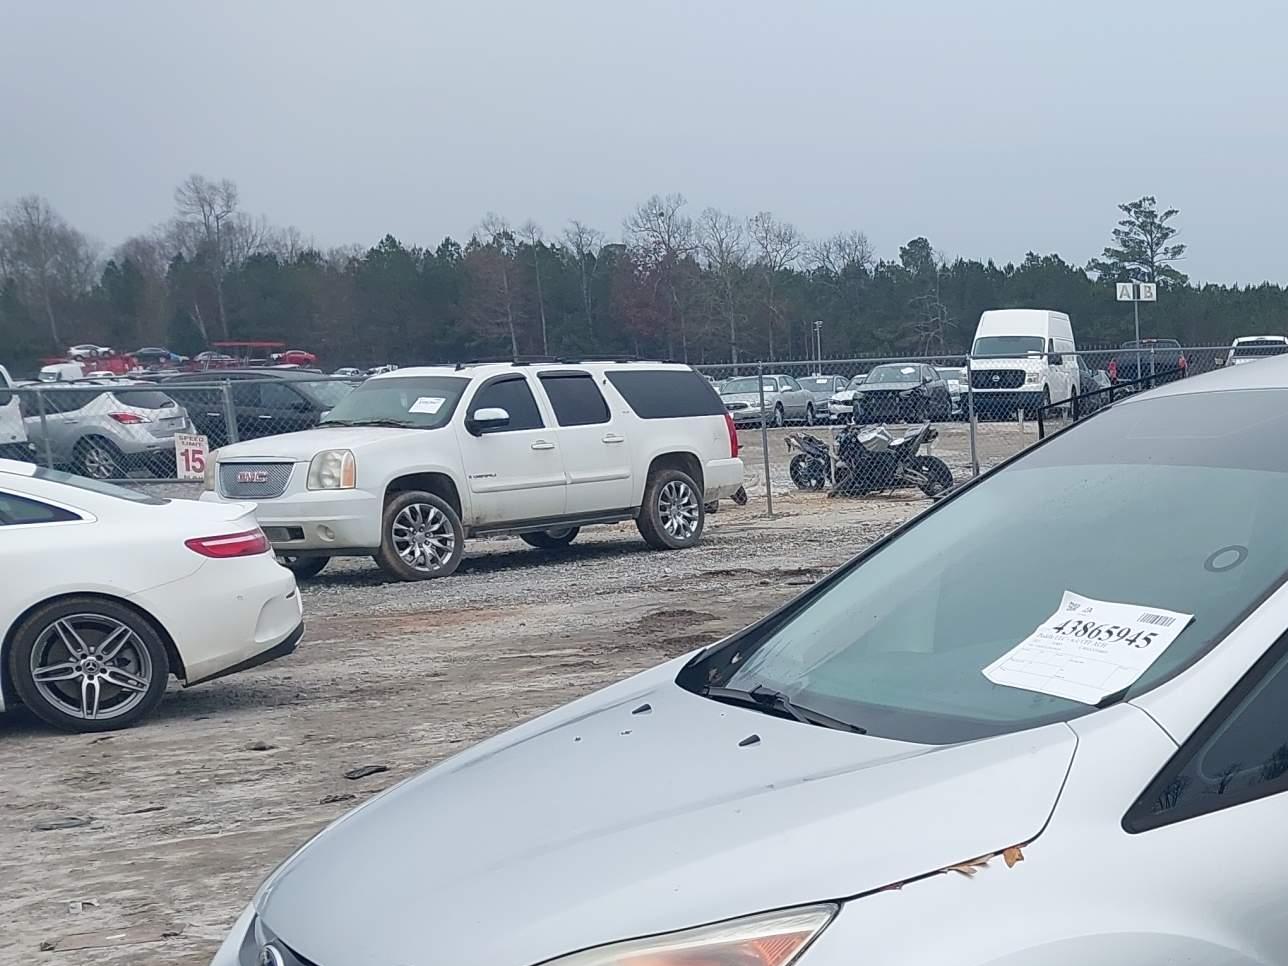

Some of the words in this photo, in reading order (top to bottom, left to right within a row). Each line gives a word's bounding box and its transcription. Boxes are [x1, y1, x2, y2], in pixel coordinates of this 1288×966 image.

[1119, 285, 1131, 299] A
[1143, 285, 1153, 299] B
[180, 448, 205, 473] 15
[1052, 619, 1159, 649] 43865945
